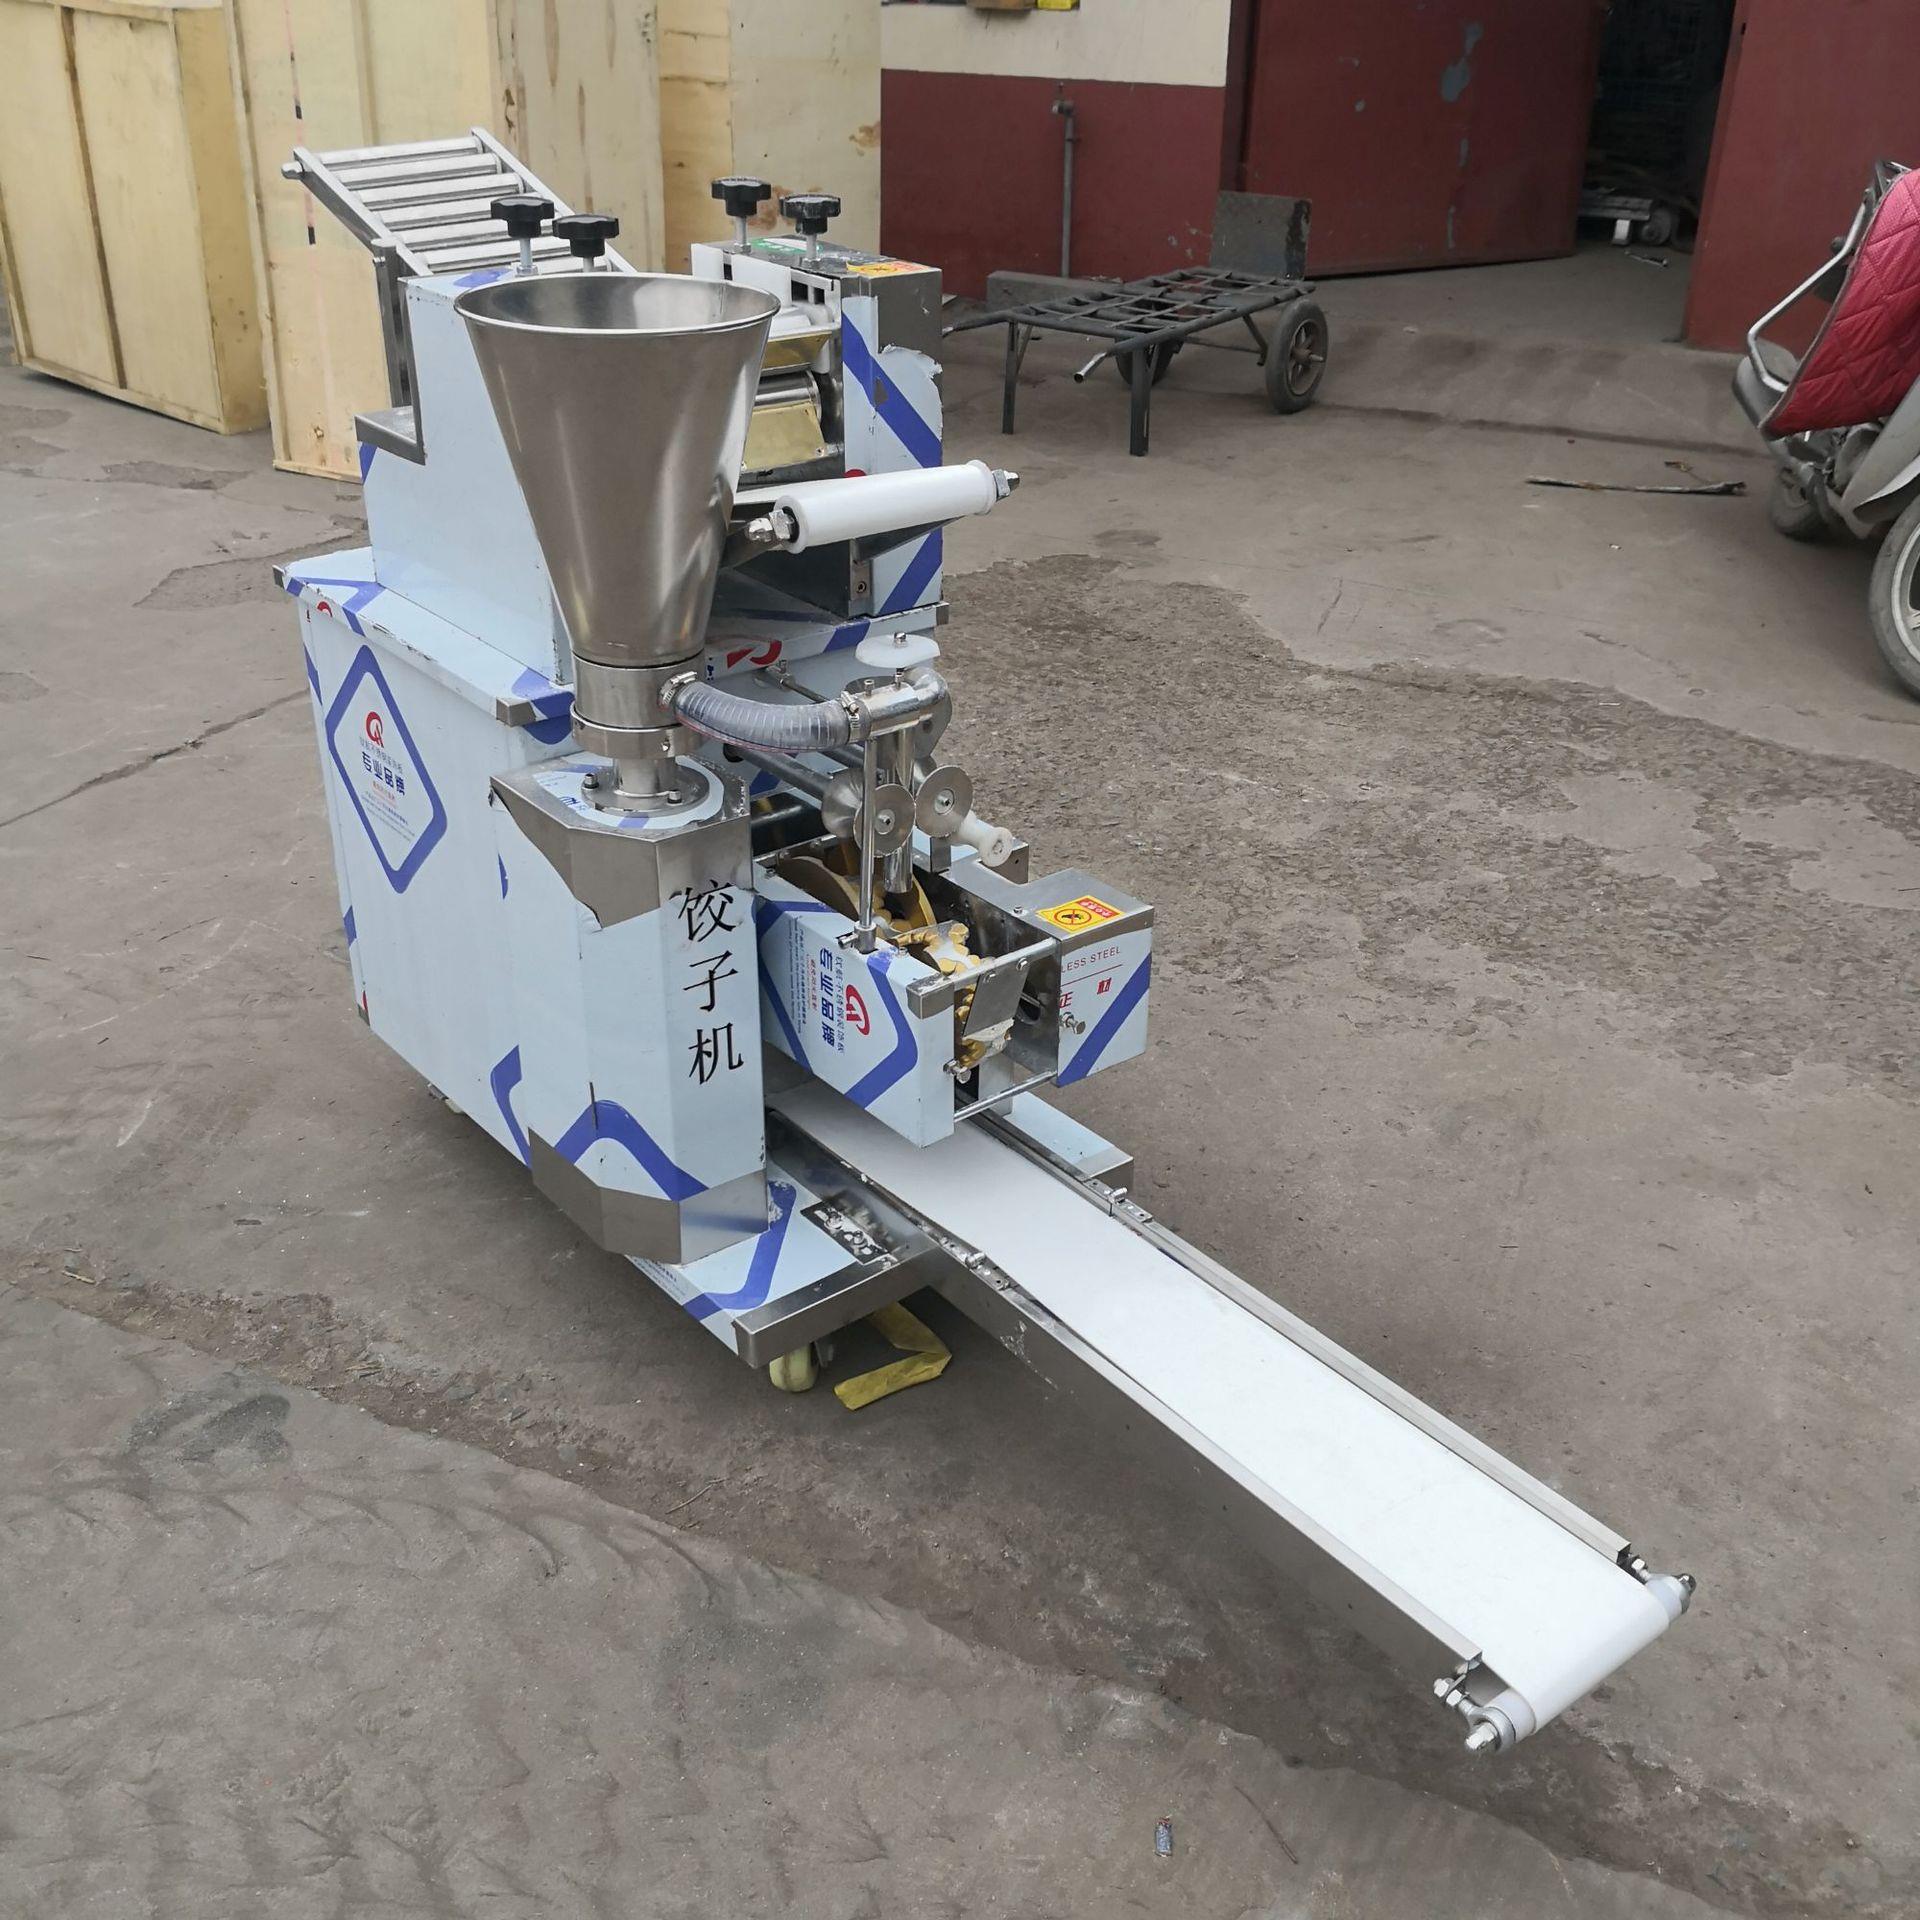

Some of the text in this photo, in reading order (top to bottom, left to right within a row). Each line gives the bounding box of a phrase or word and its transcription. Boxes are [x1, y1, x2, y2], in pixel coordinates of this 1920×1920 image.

[361, 751, 405, 796] 专业品牌
[678, 879, 744, 1085] 饺子机
[1090, 946, 1121, 963] STEEL
[820, 946, 836, 1048] 专业品牌
